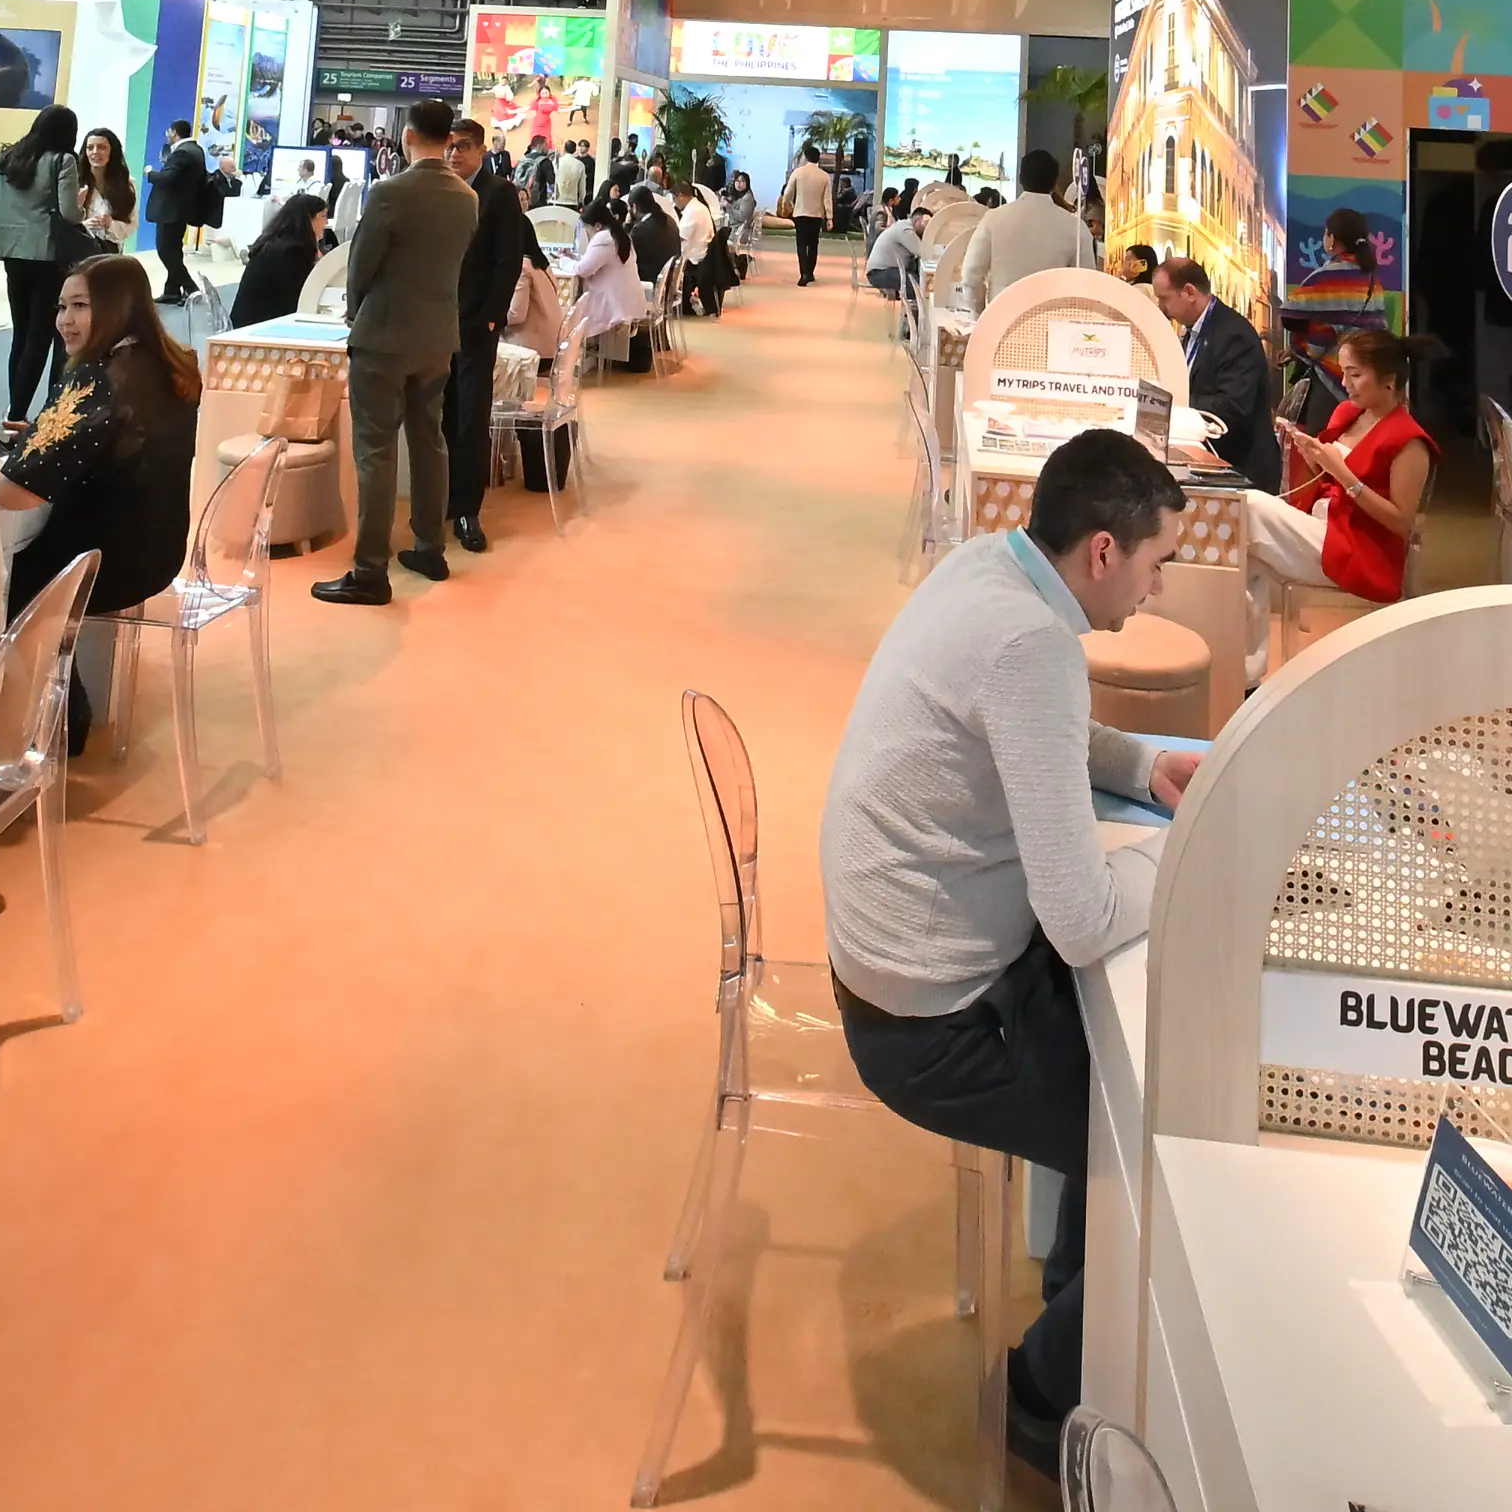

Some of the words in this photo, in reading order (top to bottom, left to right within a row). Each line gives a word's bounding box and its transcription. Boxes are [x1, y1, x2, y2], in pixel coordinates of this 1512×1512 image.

[713, 58, 729, 68] THE
[734, 60, 798, 71] PHILIPPINES
[322, 72, 338, 85] 25
[400, 76, 416, 88] 25
[420, 74, 457, 84] Segments
[997, 377, 1015, 389] MY
[1015, 378, 1046, 391] TRIPS
[1048, 381, 1088, 394] TRAVEL
[1091, 384, 1115, 396] AND
